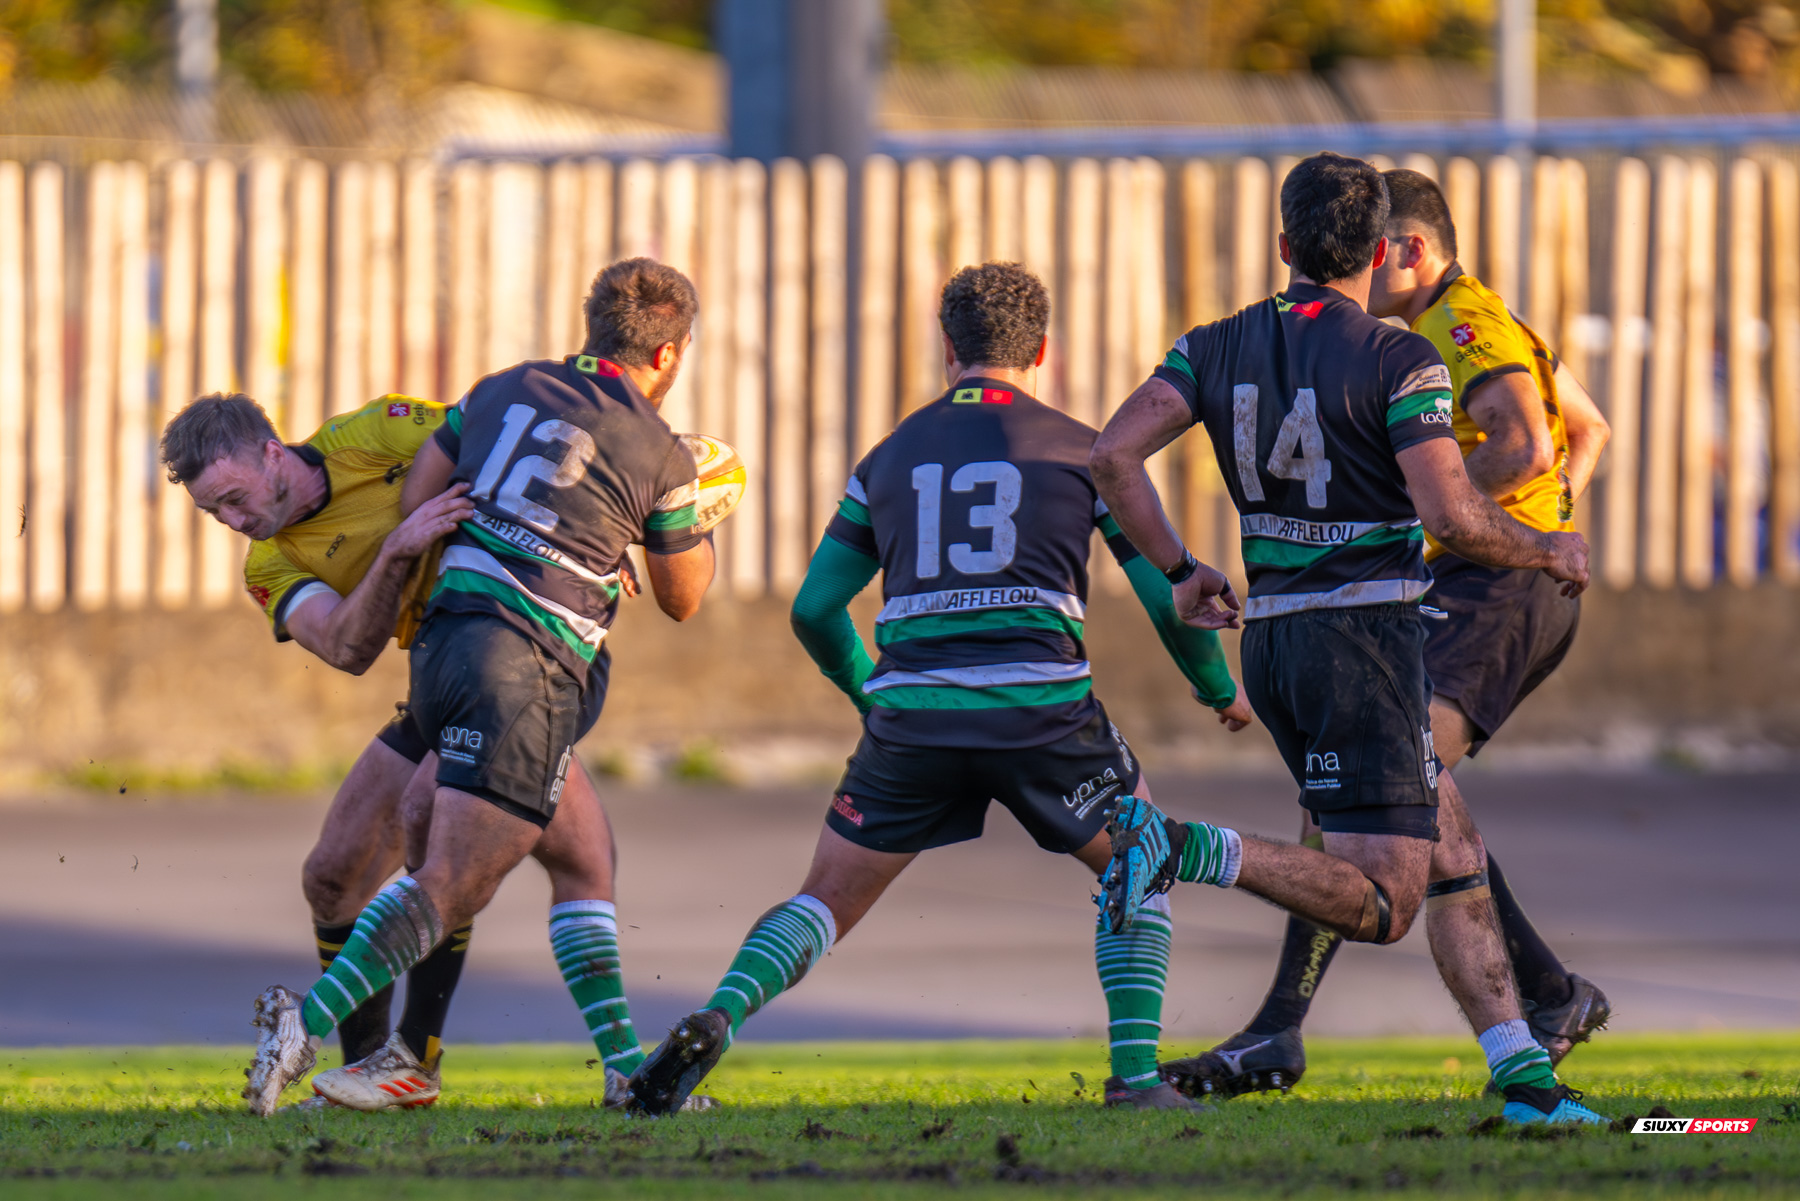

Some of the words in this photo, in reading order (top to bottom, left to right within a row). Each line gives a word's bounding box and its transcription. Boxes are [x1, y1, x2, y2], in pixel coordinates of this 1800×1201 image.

[1232, 383, 1332, 508] 14
[468, 403, 596, 532] 12
[912, 460, 1022, 579] 13
[1277, 518, 1355, 543] AFFLELOU
[945, 587, 1038, 610] AFFLELOU
[441, 725, 482, 749] upna
[1062, 766, 1119, 807] upna
